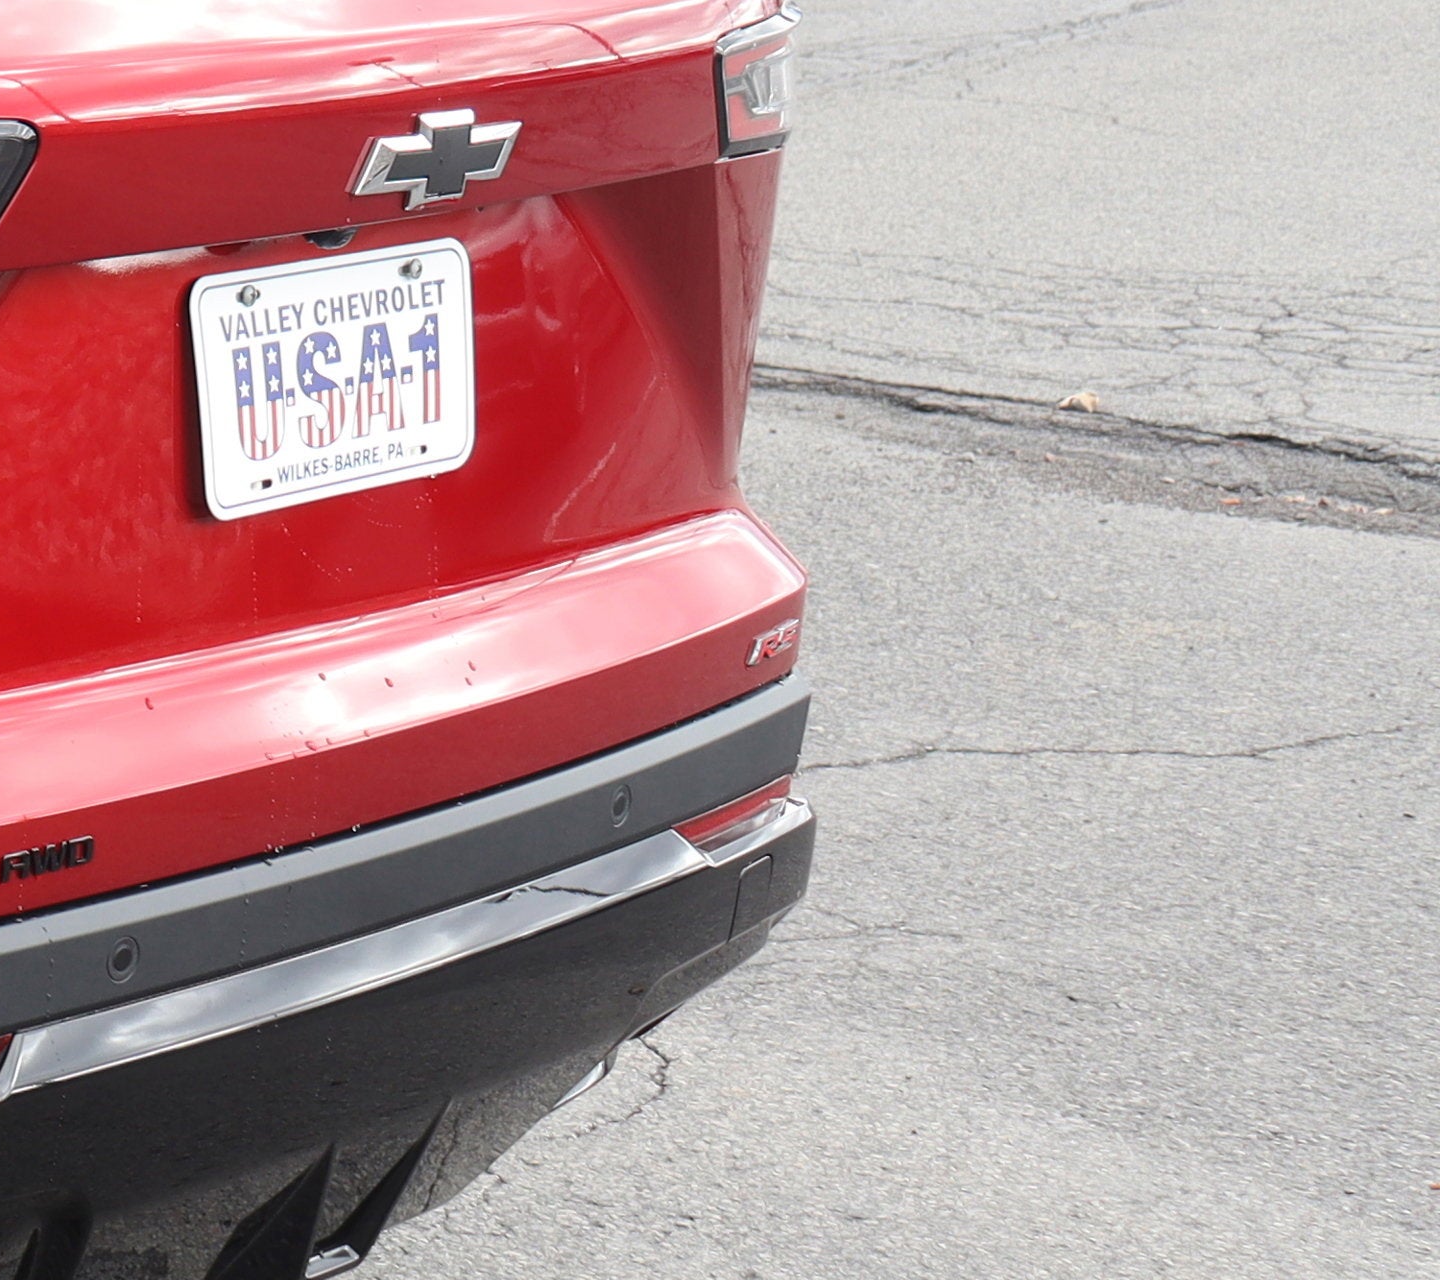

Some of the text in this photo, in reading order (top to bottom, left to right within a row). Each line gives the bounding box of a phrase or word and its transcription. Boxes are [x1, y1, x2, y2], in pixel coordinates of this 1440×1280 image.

[220, 278, 446, 343] VALLEY CHEVROLET
[277, 443, 404, 484] WILKES-BARRE, PA
[0, 835, 95, 884] AWD
